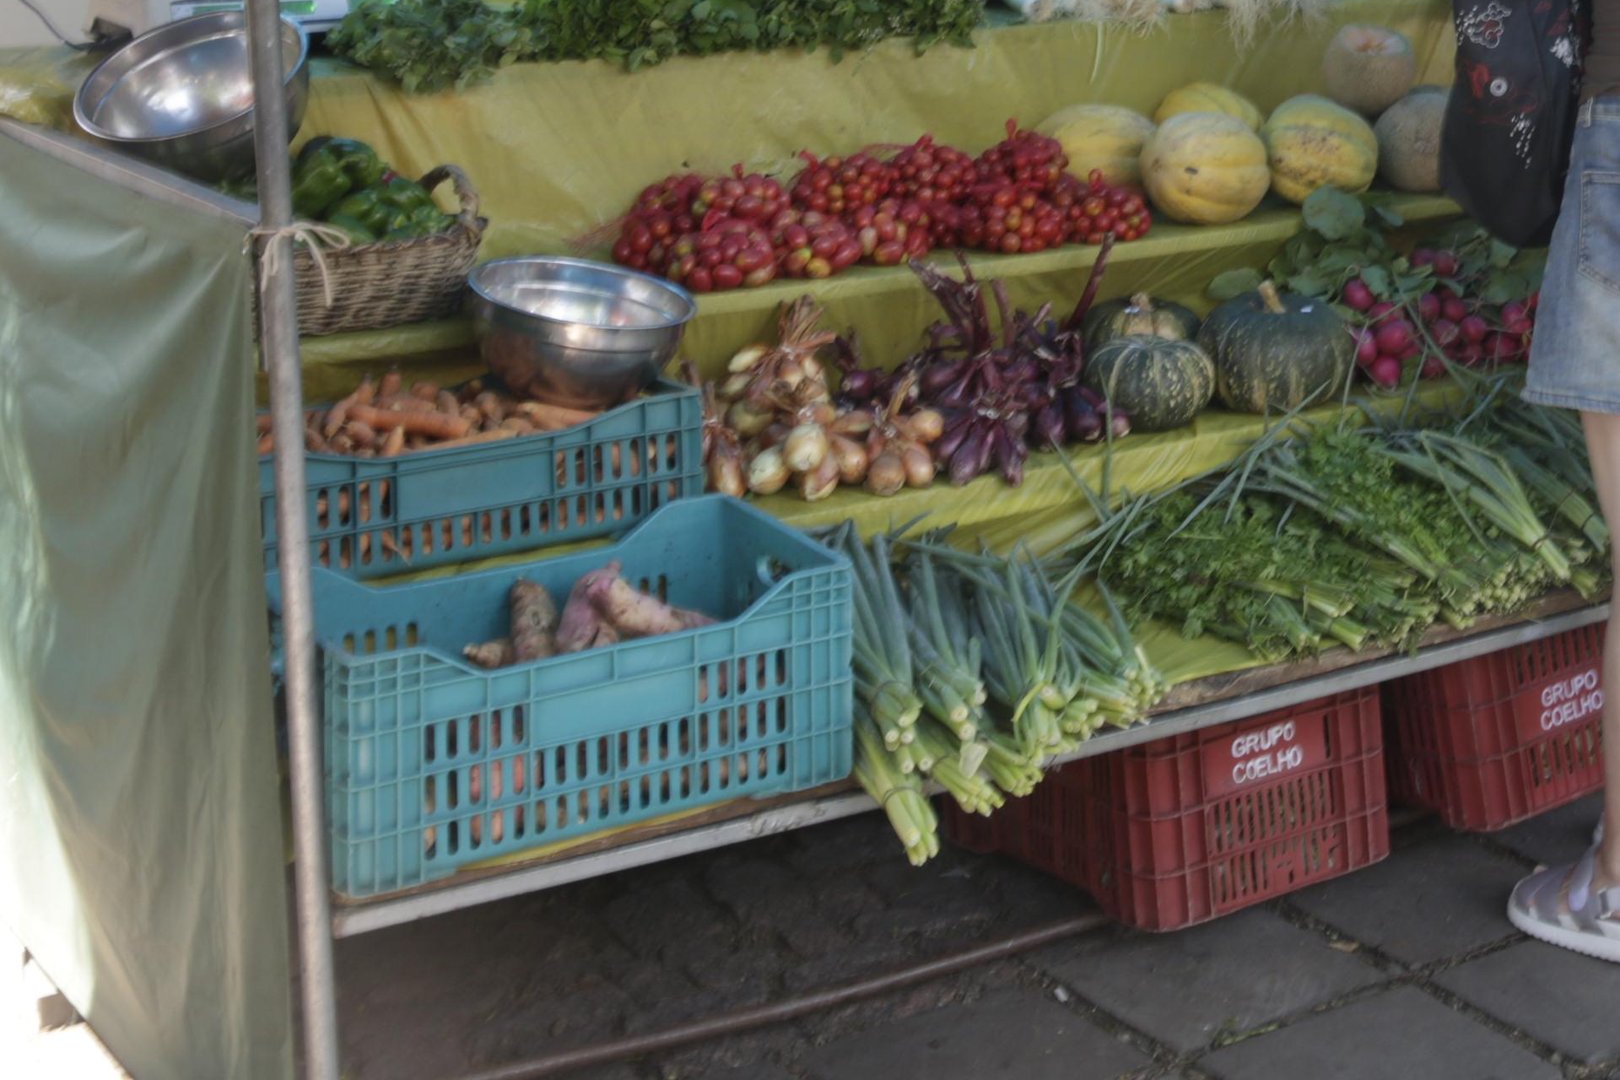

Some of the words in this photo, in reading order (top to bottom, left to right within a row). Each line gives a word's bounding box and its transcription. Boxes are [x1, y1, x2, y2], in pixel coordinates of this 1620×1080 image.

[1541, 669, 1598, 708] GRUPO
[1540, 690, 1605, 731] COELHO
[1231, 720, 1297, 758] GRUPO
[1232, 745, 1304, 784] COELHO
